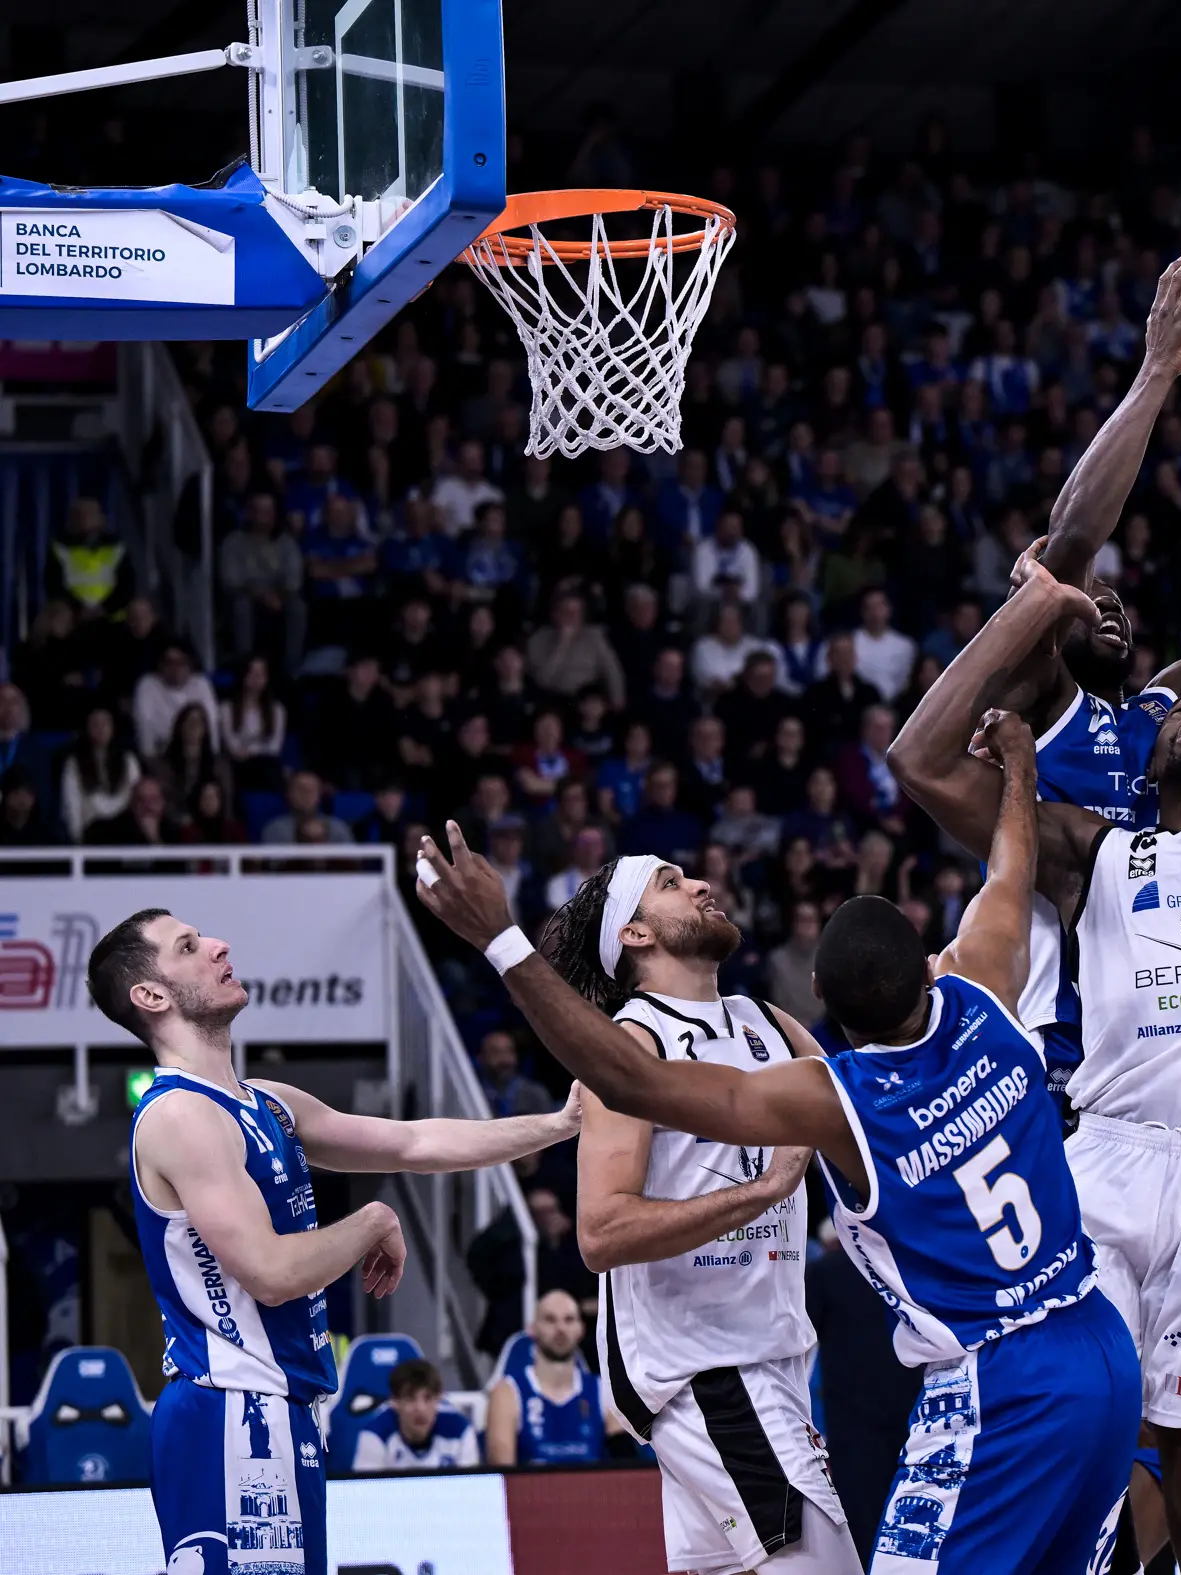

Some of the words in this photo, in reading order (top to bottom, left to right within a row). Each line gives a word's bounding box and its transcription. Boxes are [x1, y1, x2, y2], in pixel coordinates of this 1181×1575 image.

[15, 222, 81, 239] BANCA
[15, 242, 51, 258] DEL
[55, 244, 166, 262] TERRITORIO
[15, 262, 122, 279] LOMBARDO
[1093, 745, 1121, 755] errea
[951, 1011, 988, 1051] BERNARDELLI
[1137, 1023, 1181, 1039] Allianz
[895, 1065, 1029, 1188] MASSINBURG
[952, 1134, 1042, 1271] 5
[693, 1255, 737, 1267] Allianz
[777, 1250, 800, 1261] SYNERGIE
[301, 1457, 319, 1468] errea
